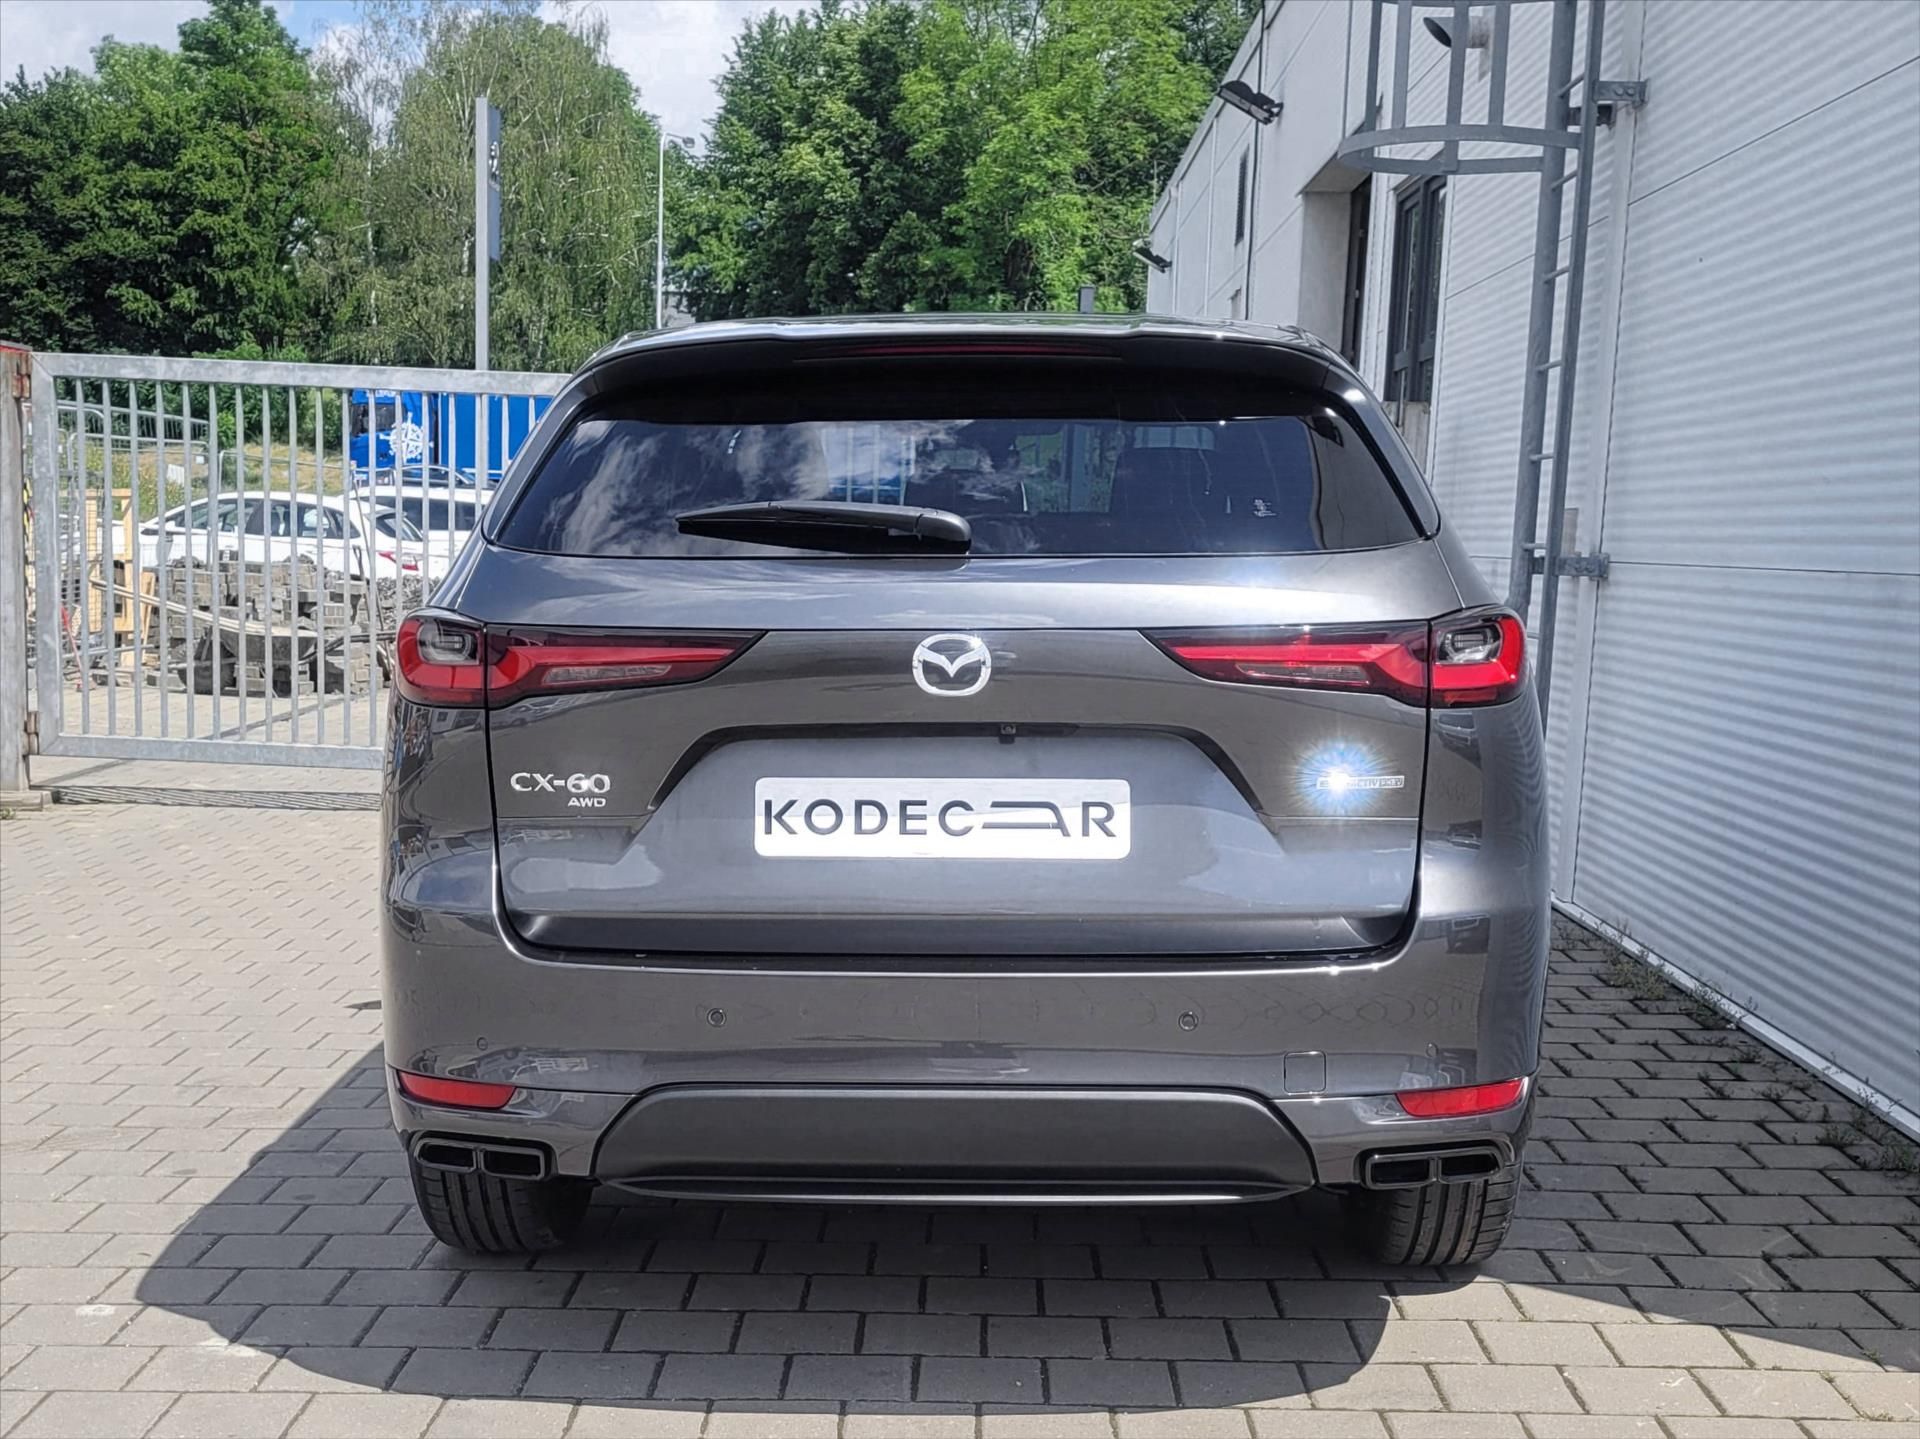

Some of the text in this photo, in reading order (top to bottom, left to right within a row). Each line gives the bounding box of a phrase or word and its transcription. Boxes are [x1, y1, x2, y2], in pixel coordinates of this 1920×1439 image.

[510, 772, 611, 793] CX-60
[567, 797, 606, 807] AWD
[764, 799, 1116, 837] KODECAR
